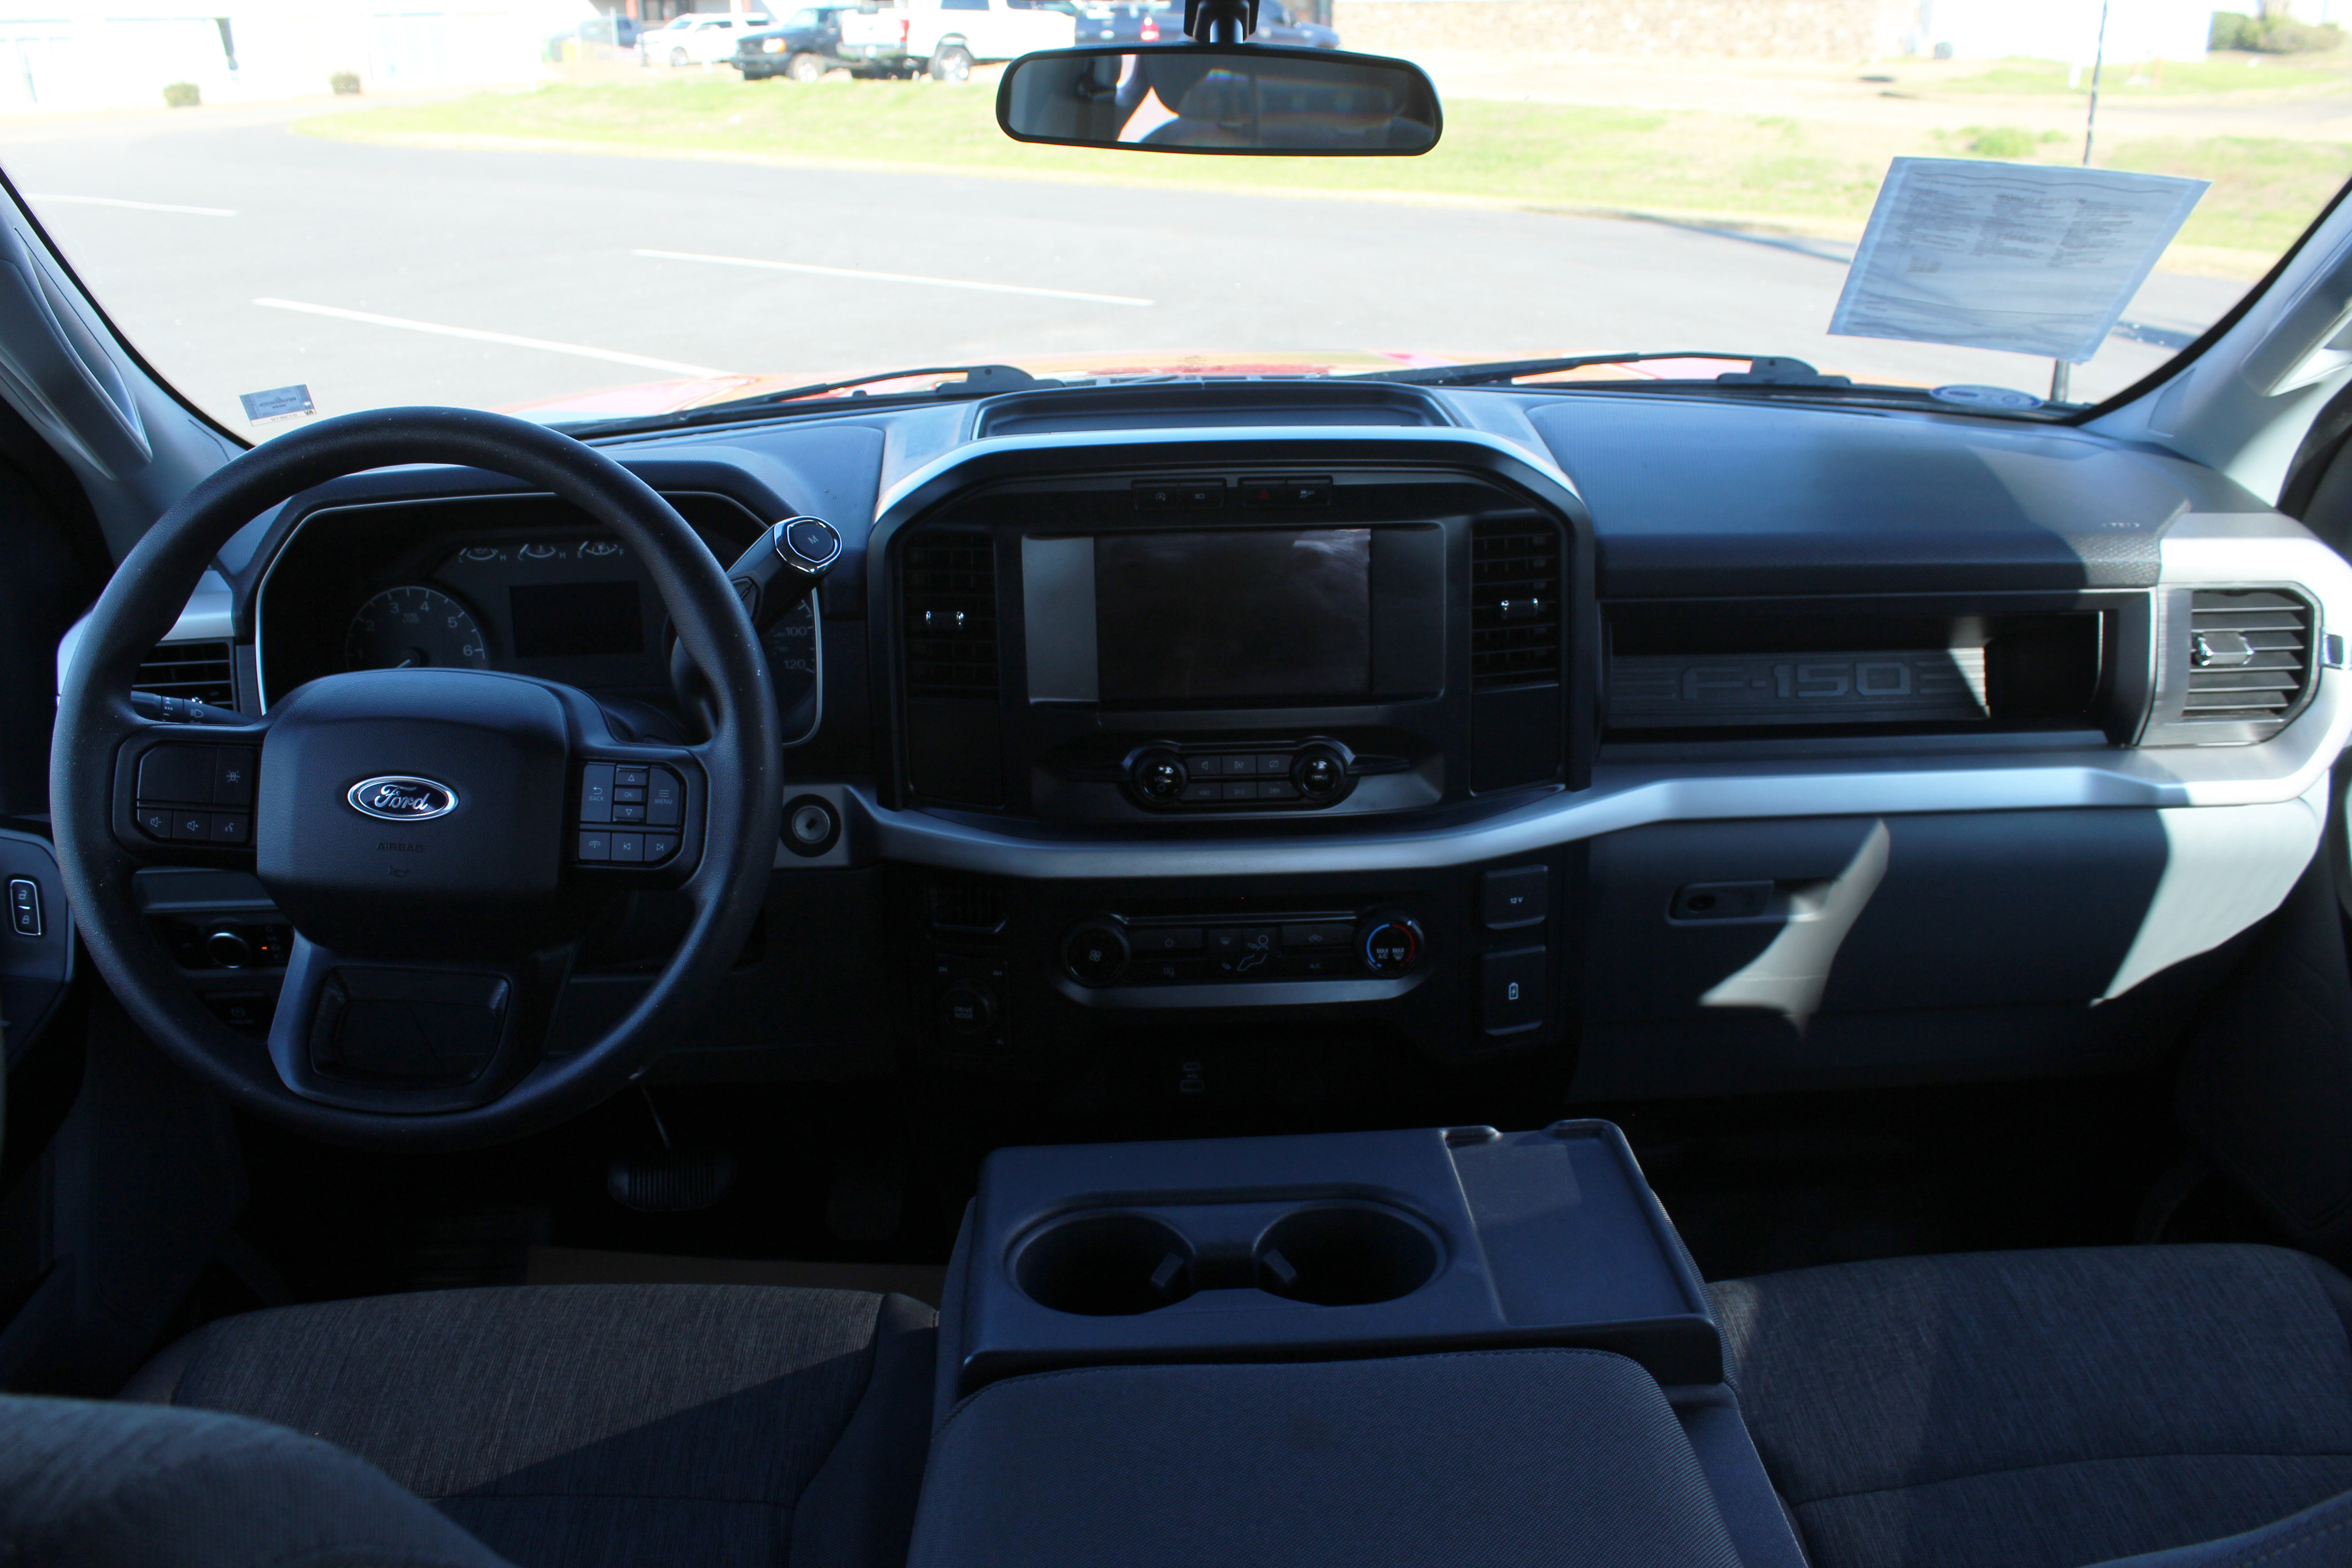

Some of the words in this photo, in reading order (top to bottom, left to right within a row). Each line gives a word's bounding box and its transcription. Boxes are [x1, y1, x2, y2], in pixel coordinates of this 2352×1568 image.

[808, 536, 818, 544] M
[390, 602, 399, 613] 3
[420, 601, 430, 612] 4
[366, 621, 375, 632] 2
[448, 617, 457, 628] 5
[785, 626, 807, 637] 100
[358, 650, 363, 660] 1
[463, 645, 473, 656] 6
[784, 659, 806, 670] 120
[1681, 662, 1912, 700] F-150
[374, 784, 430, 811] Ford
[376, 842, 423, 852] AIRBAG
